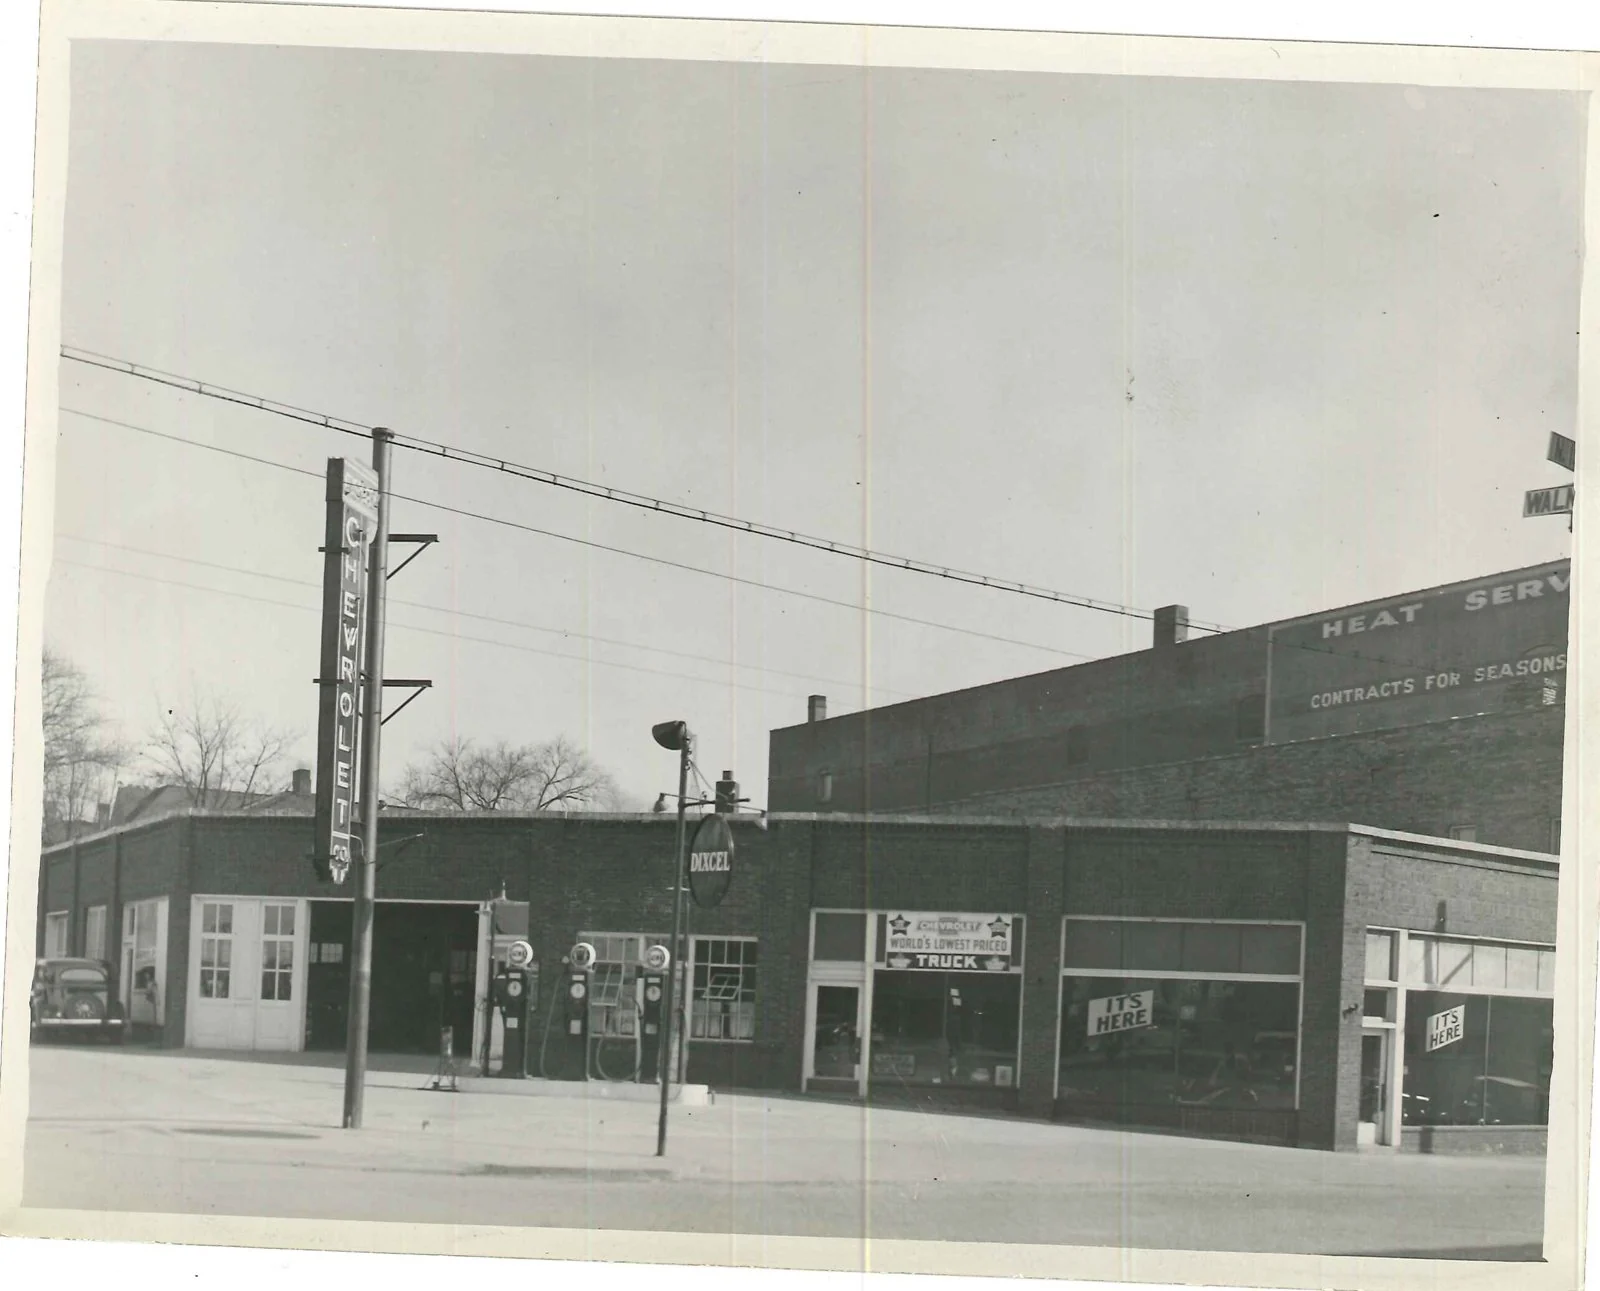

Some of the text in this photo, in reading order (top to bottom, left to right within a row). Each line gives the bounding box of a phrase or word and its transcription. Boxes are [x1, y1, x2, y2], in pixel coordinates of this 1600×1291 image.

[1322, 602, 1424, 639] HEAT
[336, 515, 361, 827] CHEVROLET
[1311, 653, 1568, 709] CONTRACTS FOR SEASONS
[690, 851, 730, 872] DIXCEL
[890, 936, 1008, 951] WORLD'S LOWEST PRICED
[916, 954, 978, 969] TRUCK
[1096, 1008, 1147, 1033] HERE
[1430, 1024, 1461, 1048] HERE
